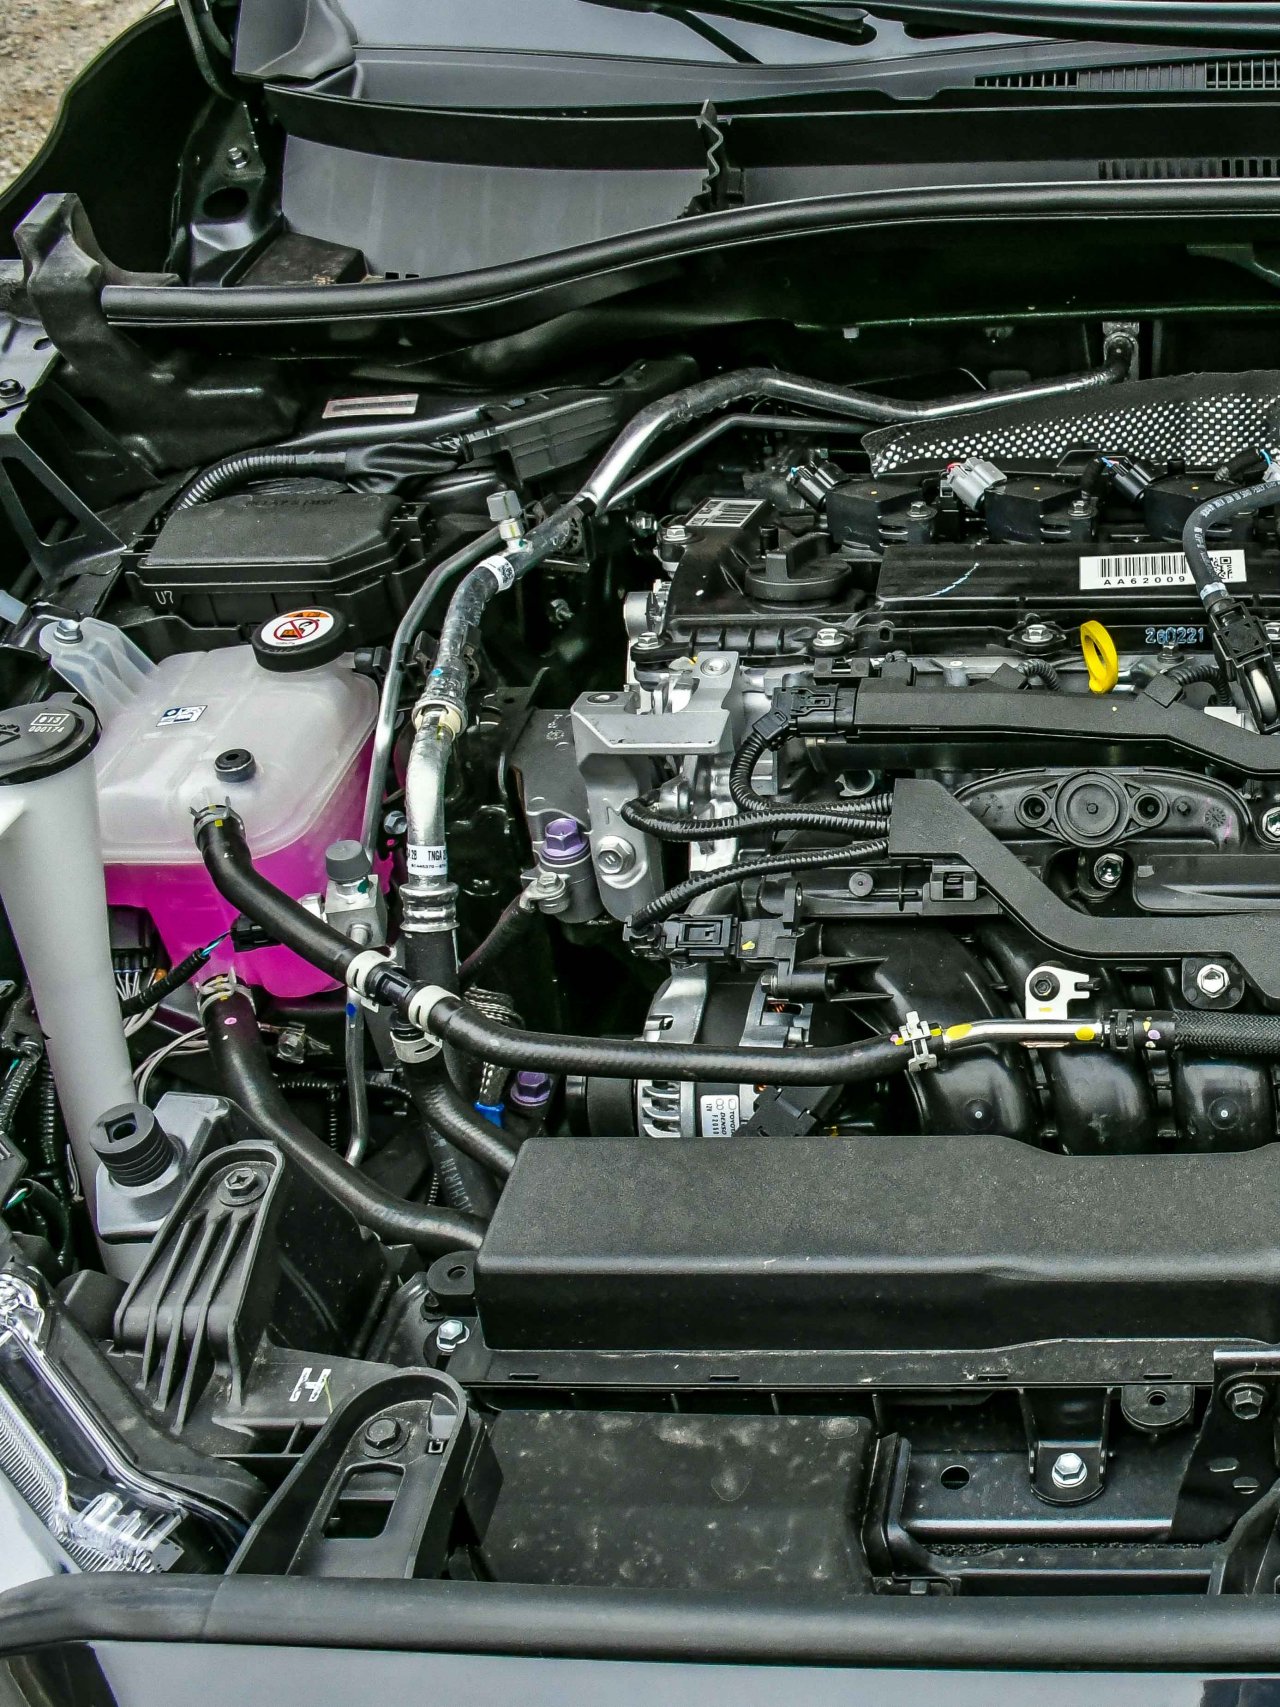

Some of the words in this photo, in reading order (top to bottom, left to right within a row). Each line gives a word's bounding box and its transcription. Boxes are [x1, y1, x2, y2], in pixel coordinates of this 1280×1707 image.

[1103, 575, 1186, 586] AA62009
[155, 590, 174, 604] U7
[428, 850, 442, 861] TNGA
[440, 1158, 475, 1213] ICHIRIN
[288, 1367, 332, 1402] H
